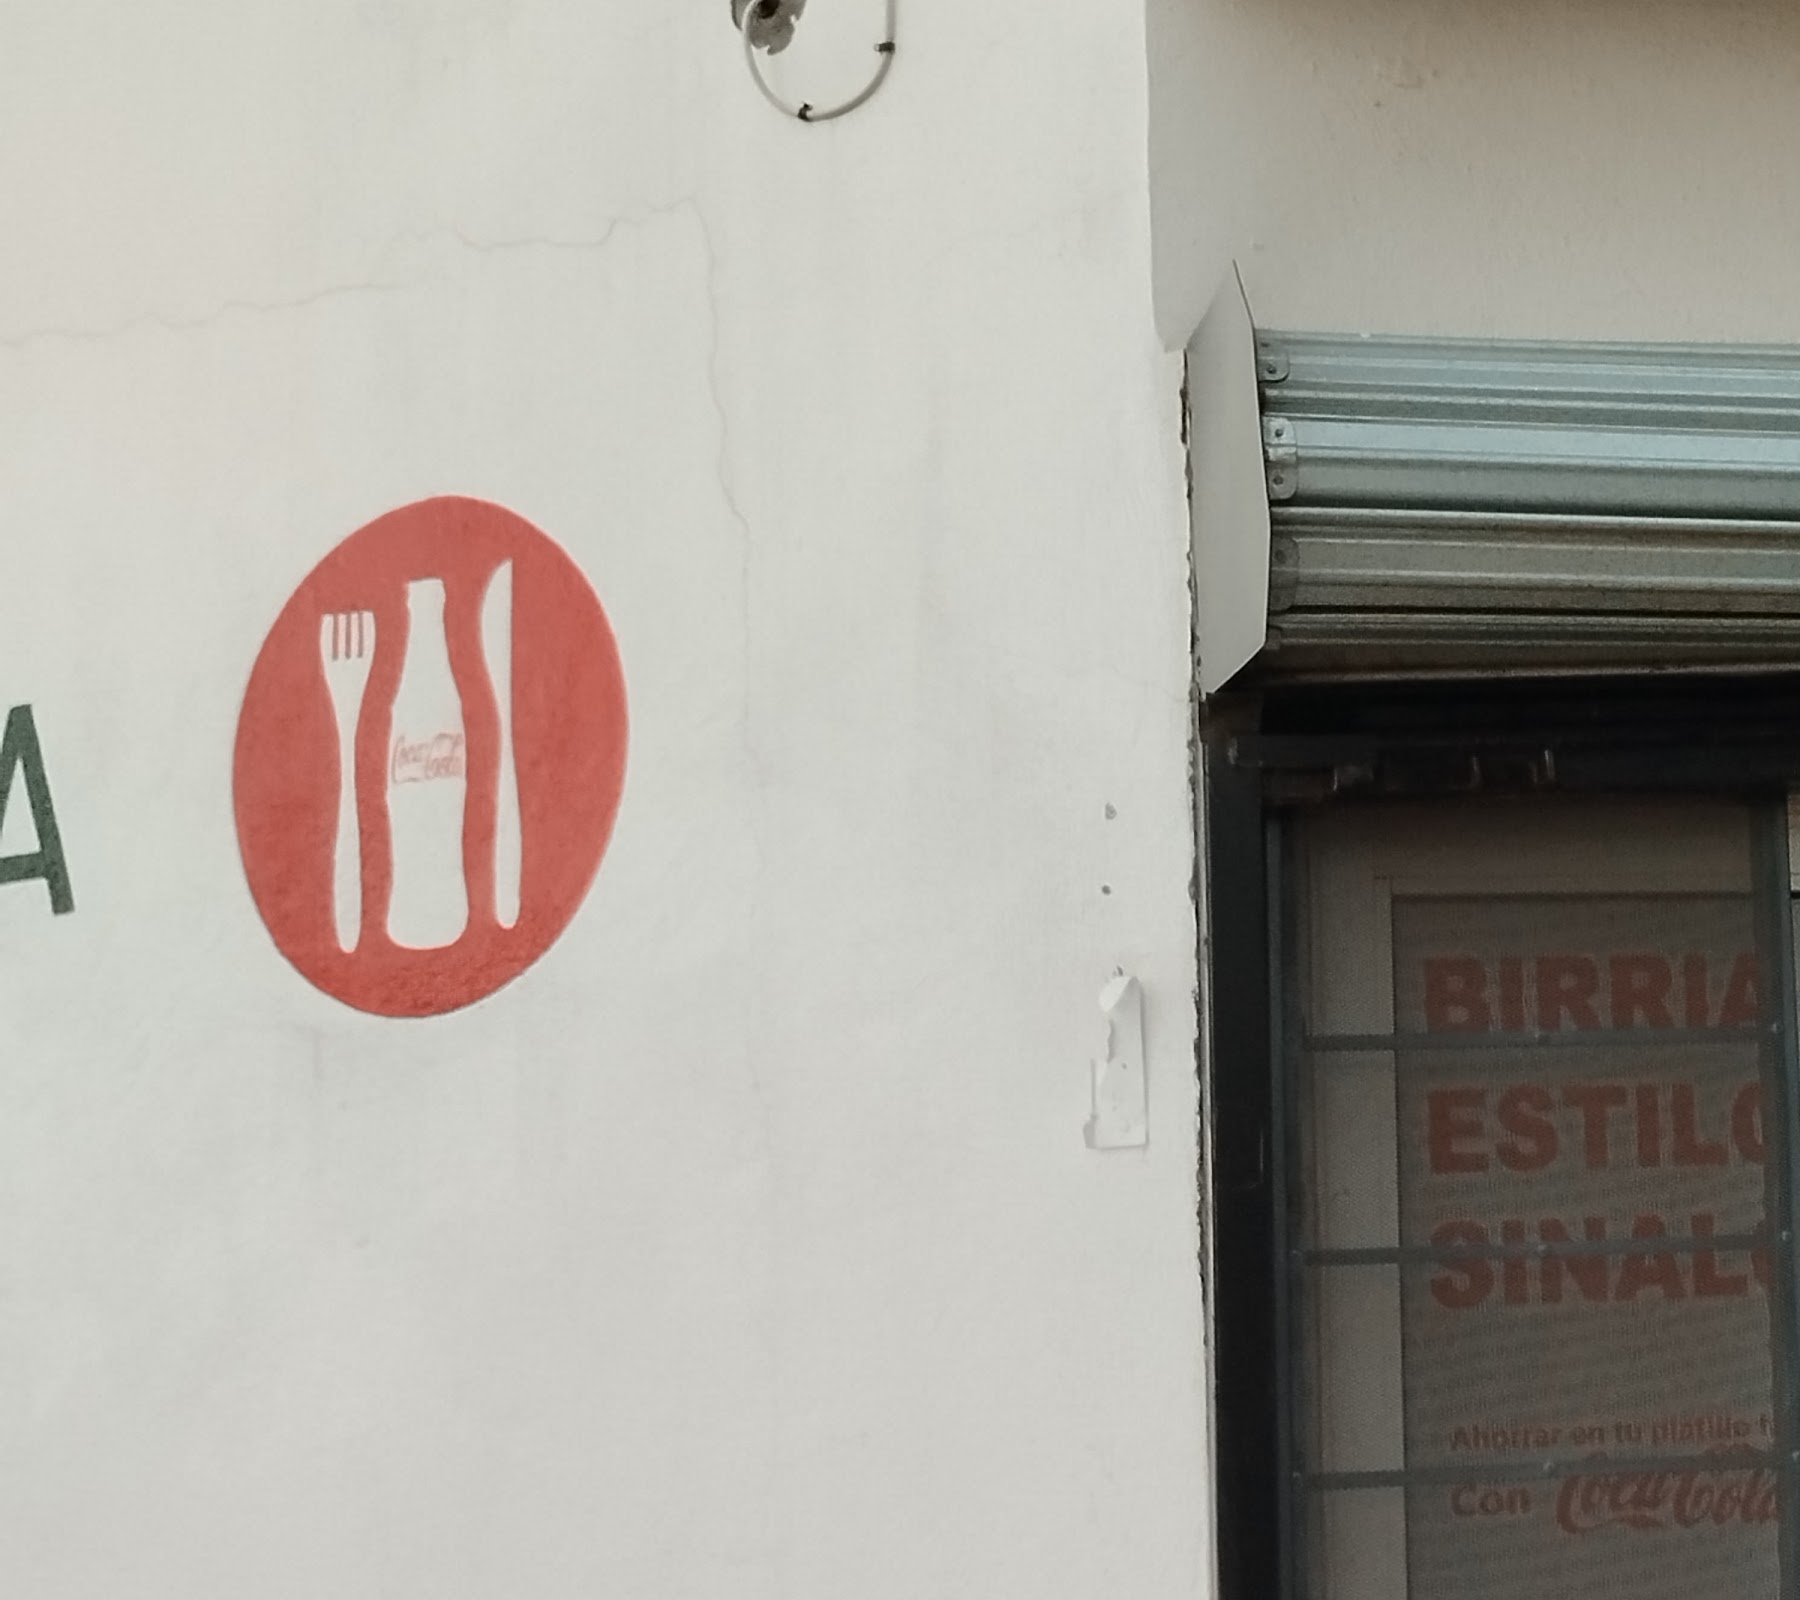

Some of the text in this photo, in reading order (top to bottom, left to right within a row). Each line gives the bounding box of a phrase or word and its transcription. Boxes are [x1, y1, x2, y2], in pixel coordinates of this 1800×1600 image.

[1571, 1425, 1604, 1446] en
[1615, 1419, 1642, 1443] tu
[1451, 1481, 1531, 1517] Con
